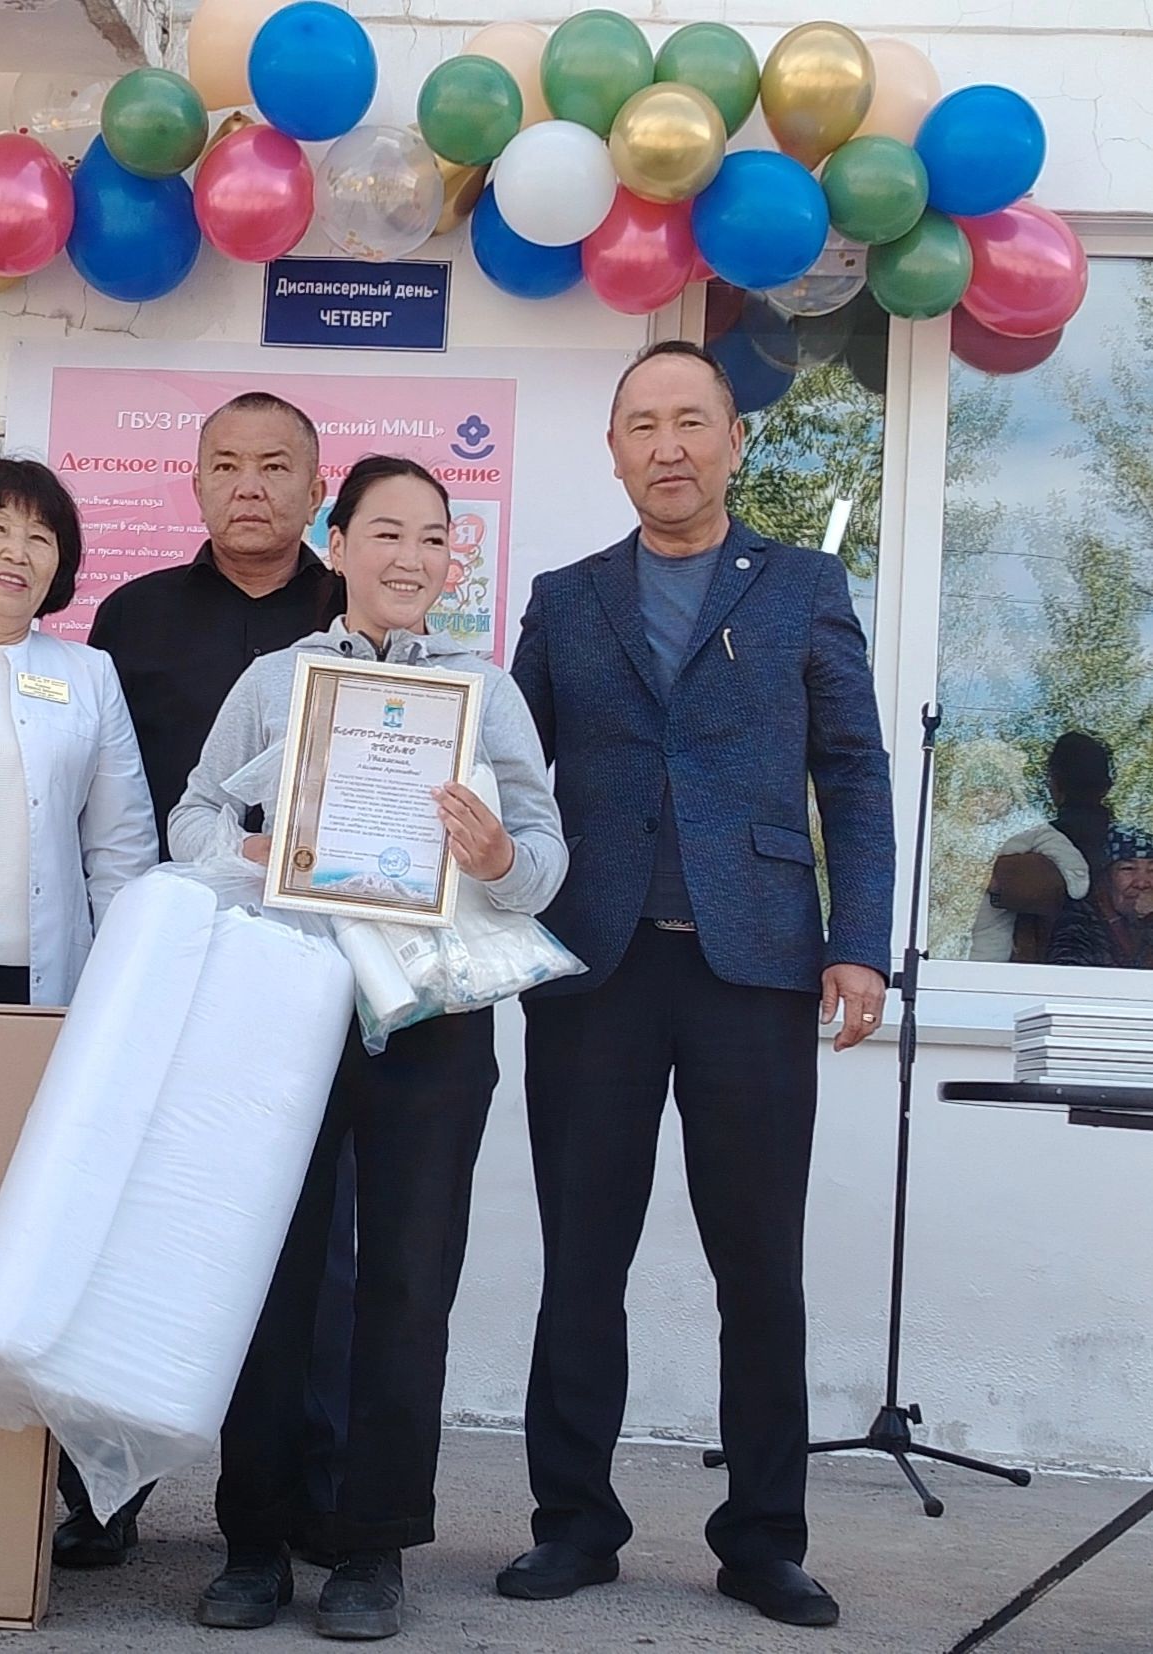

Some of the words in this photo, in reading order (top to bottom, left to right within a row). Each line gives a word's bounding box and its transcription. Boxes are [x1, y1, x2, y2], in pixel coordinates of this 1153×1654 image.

[275, 277, 392, 299] Диспансерный
[394, 284, 440, 300] день-
[320, 309, 393, 328] ЧЕТВЕРГ
[116, 411, 173, 430] ГБУЗ
[176, 412, 206, 431] РТ
[313, 418, 377, 436] мский
[380, 418, 446, 438] ММЦ»
[58, 452, 158, 474] Детское
[432, 466, 502, 484] ление
[454, 523, 477, 545] Я
